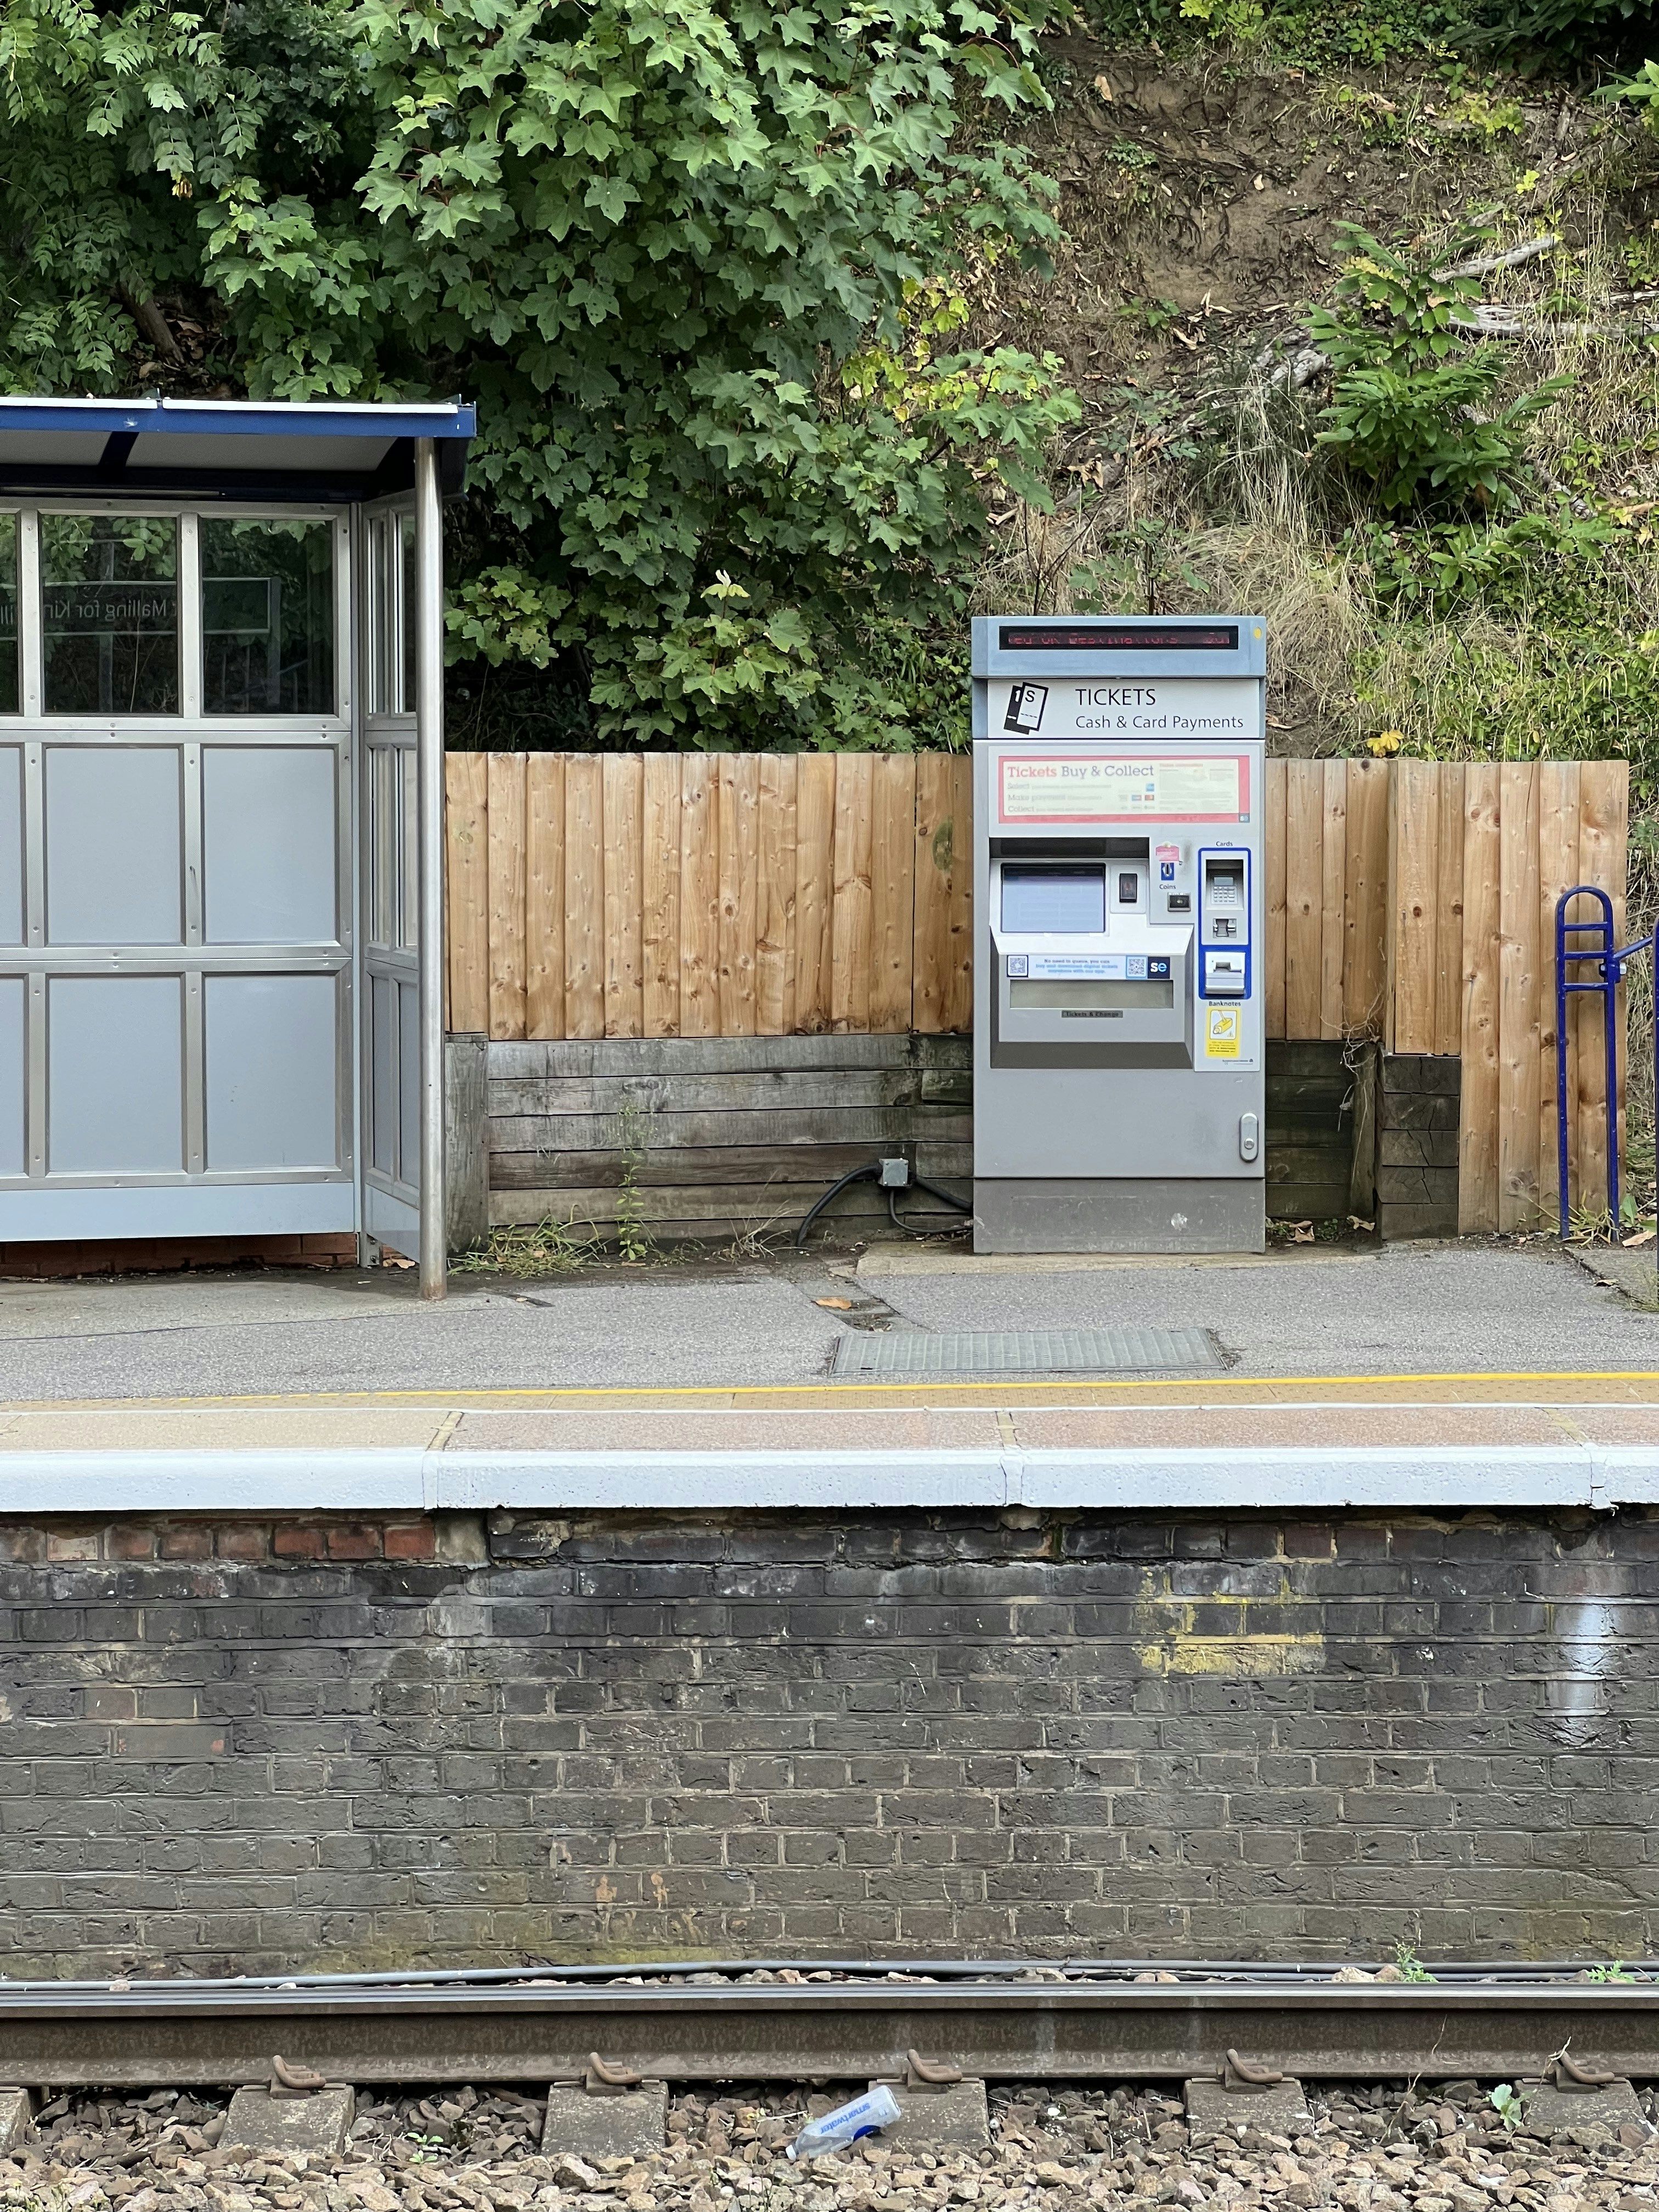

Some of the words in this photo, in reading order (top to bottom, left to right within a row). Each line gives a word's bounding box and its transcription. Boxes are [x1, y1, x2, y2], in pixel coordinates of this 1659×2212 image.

[1075, 689, 1156, 706] TICKETS
[1076, 715, 1110, 729] Cash
[1116, 715, 1127, 729] &
[1133, 715, 1166, 729] Card
[1173, 715, 1244, 732] Payments
[1007, 766, 1057, 778] Tickets
[1061, 766, 1088, 780] Buy
[1091, 765, 1101, 777] &
[1104, 765, 1154, 777] Collect
[1150, 962, 1167, 973] se
[821, 2103, 871, 2134] smartwater
